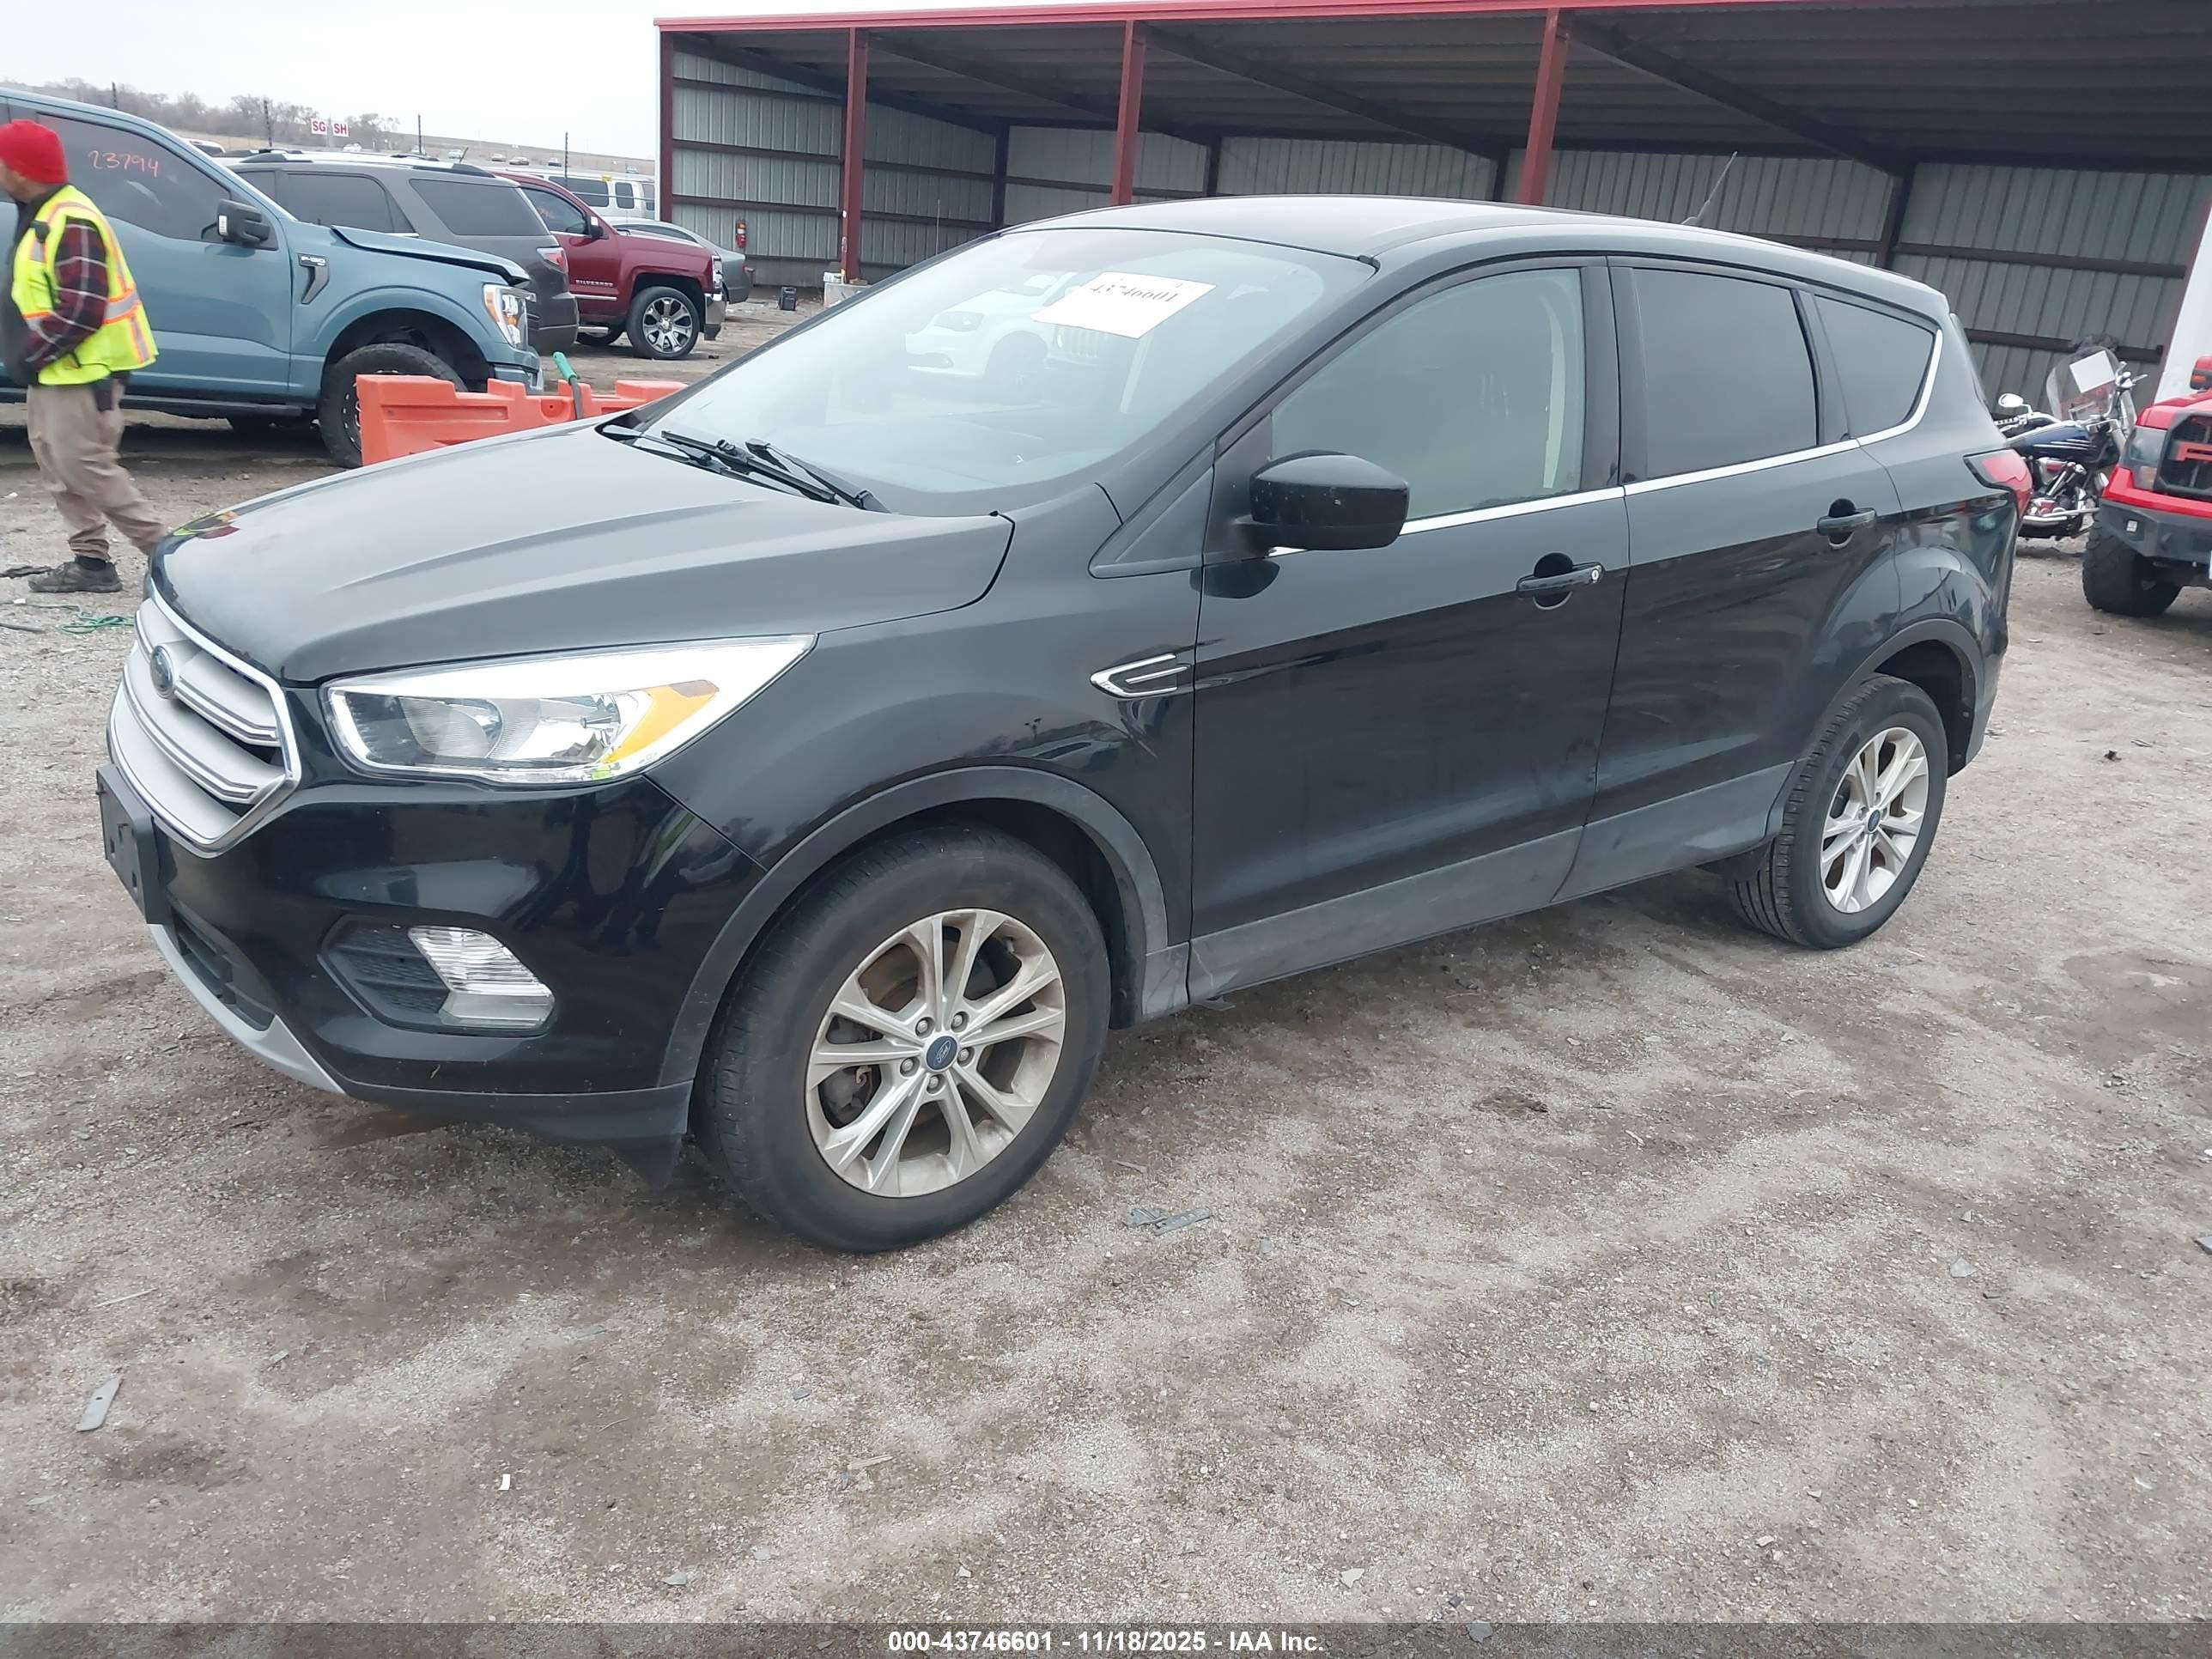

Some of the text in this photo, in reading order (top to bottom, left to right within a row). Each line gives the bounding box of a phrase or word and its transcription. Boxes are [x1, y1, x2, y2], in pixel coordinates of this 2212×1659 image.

[313, 120, 326, 131] SG
[333, 123, 347, 135] SH
[88, 150, 159, 178] 23794
